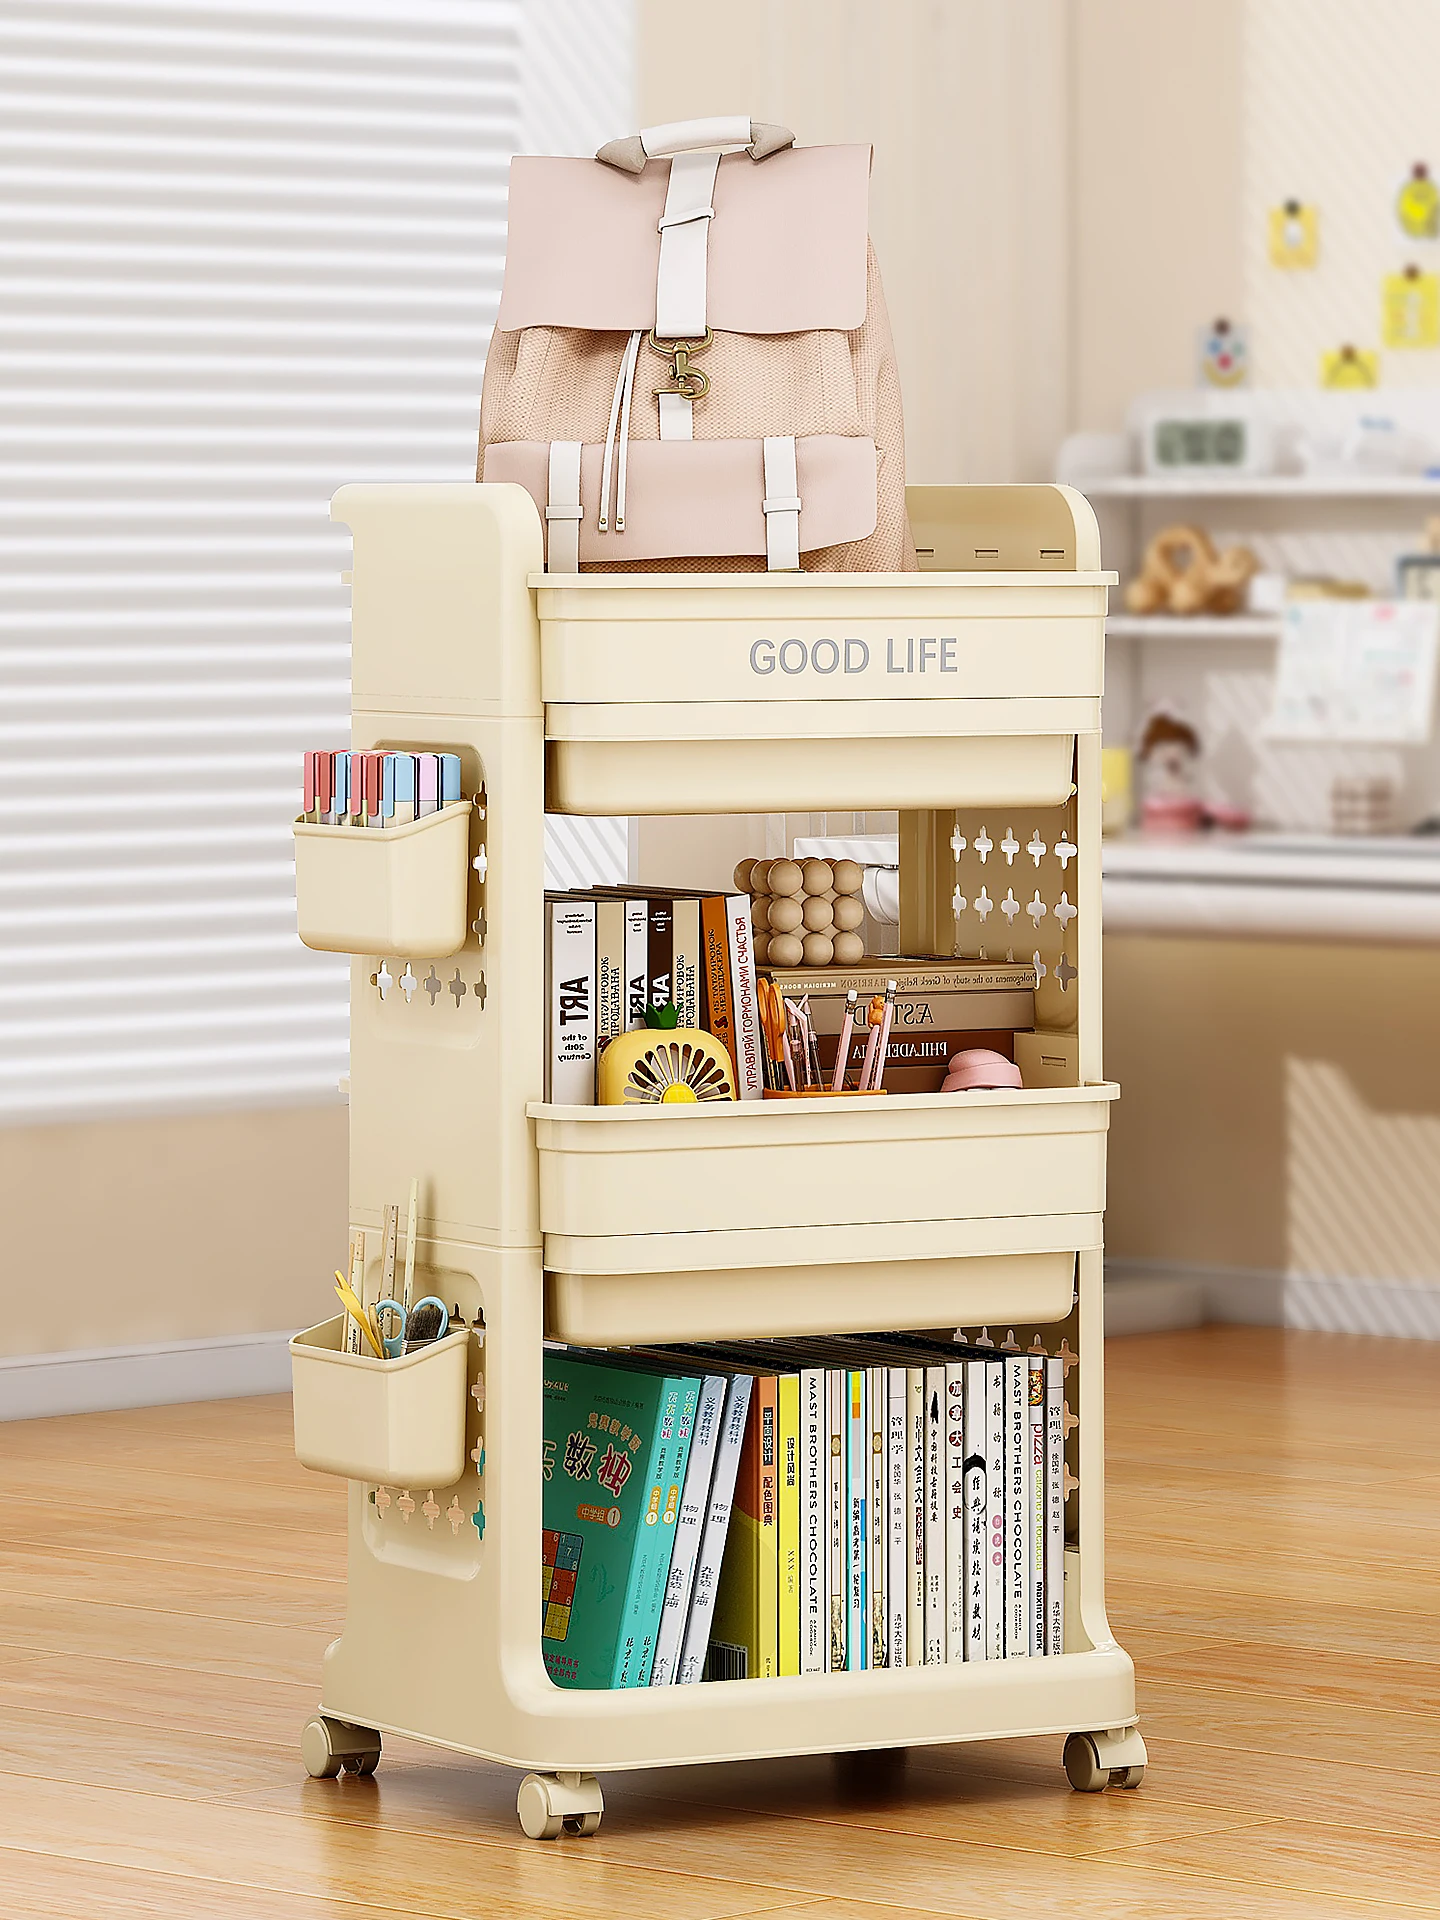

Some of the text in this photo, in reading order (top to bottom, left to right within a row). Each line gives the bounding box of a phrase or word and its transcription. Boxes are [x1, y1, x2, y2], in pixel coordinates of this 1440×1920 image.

[749, 638, 958, 675] GOOD LIFE
[708, 928, 719, 999] ТАТУИРОВОК
[715, 942, 727, 1013] МЕНЕДЖЕРА
[601, 956, 610, 1033] ТАТУИРОВОК
[611, 966, 620, 1037] ПРОДАВАНА
[735, 917, 758, 1091] УПРАВЛЯЙ ГОРМОНАМИ СЧАСТЬЯ
[698, 1396, 716, 1446] 义务教育教科书
[727, 1395, 745, 1445] 义务教育教科书
[890, 1416, 904, 1455] 管理学
[992, 1375, 1002, 1499] 书籍的名称
[1030, 1424, 1043, 1466] pizza
[1049, 1406, 1062, 1445] 管理学
[786, 1437, 796, 1487] 设计风尚
[1013, 1364, 1022, 1599] MAST BROTHERS CHOCOLATE
[581, 1506, 606, 1522] 中学组
[680, 1503, 699, 1526] 物理
[710, 1502, 729, 1525] 物理
[763, 1476, 773, 1527] 配色图典
[809, 1377, 818, 1614] MAST BROTHERS CHOCOLATE
[669, 1567, 685, 1590] 九年级
[698, 1566, 714, 1589] 九年级
